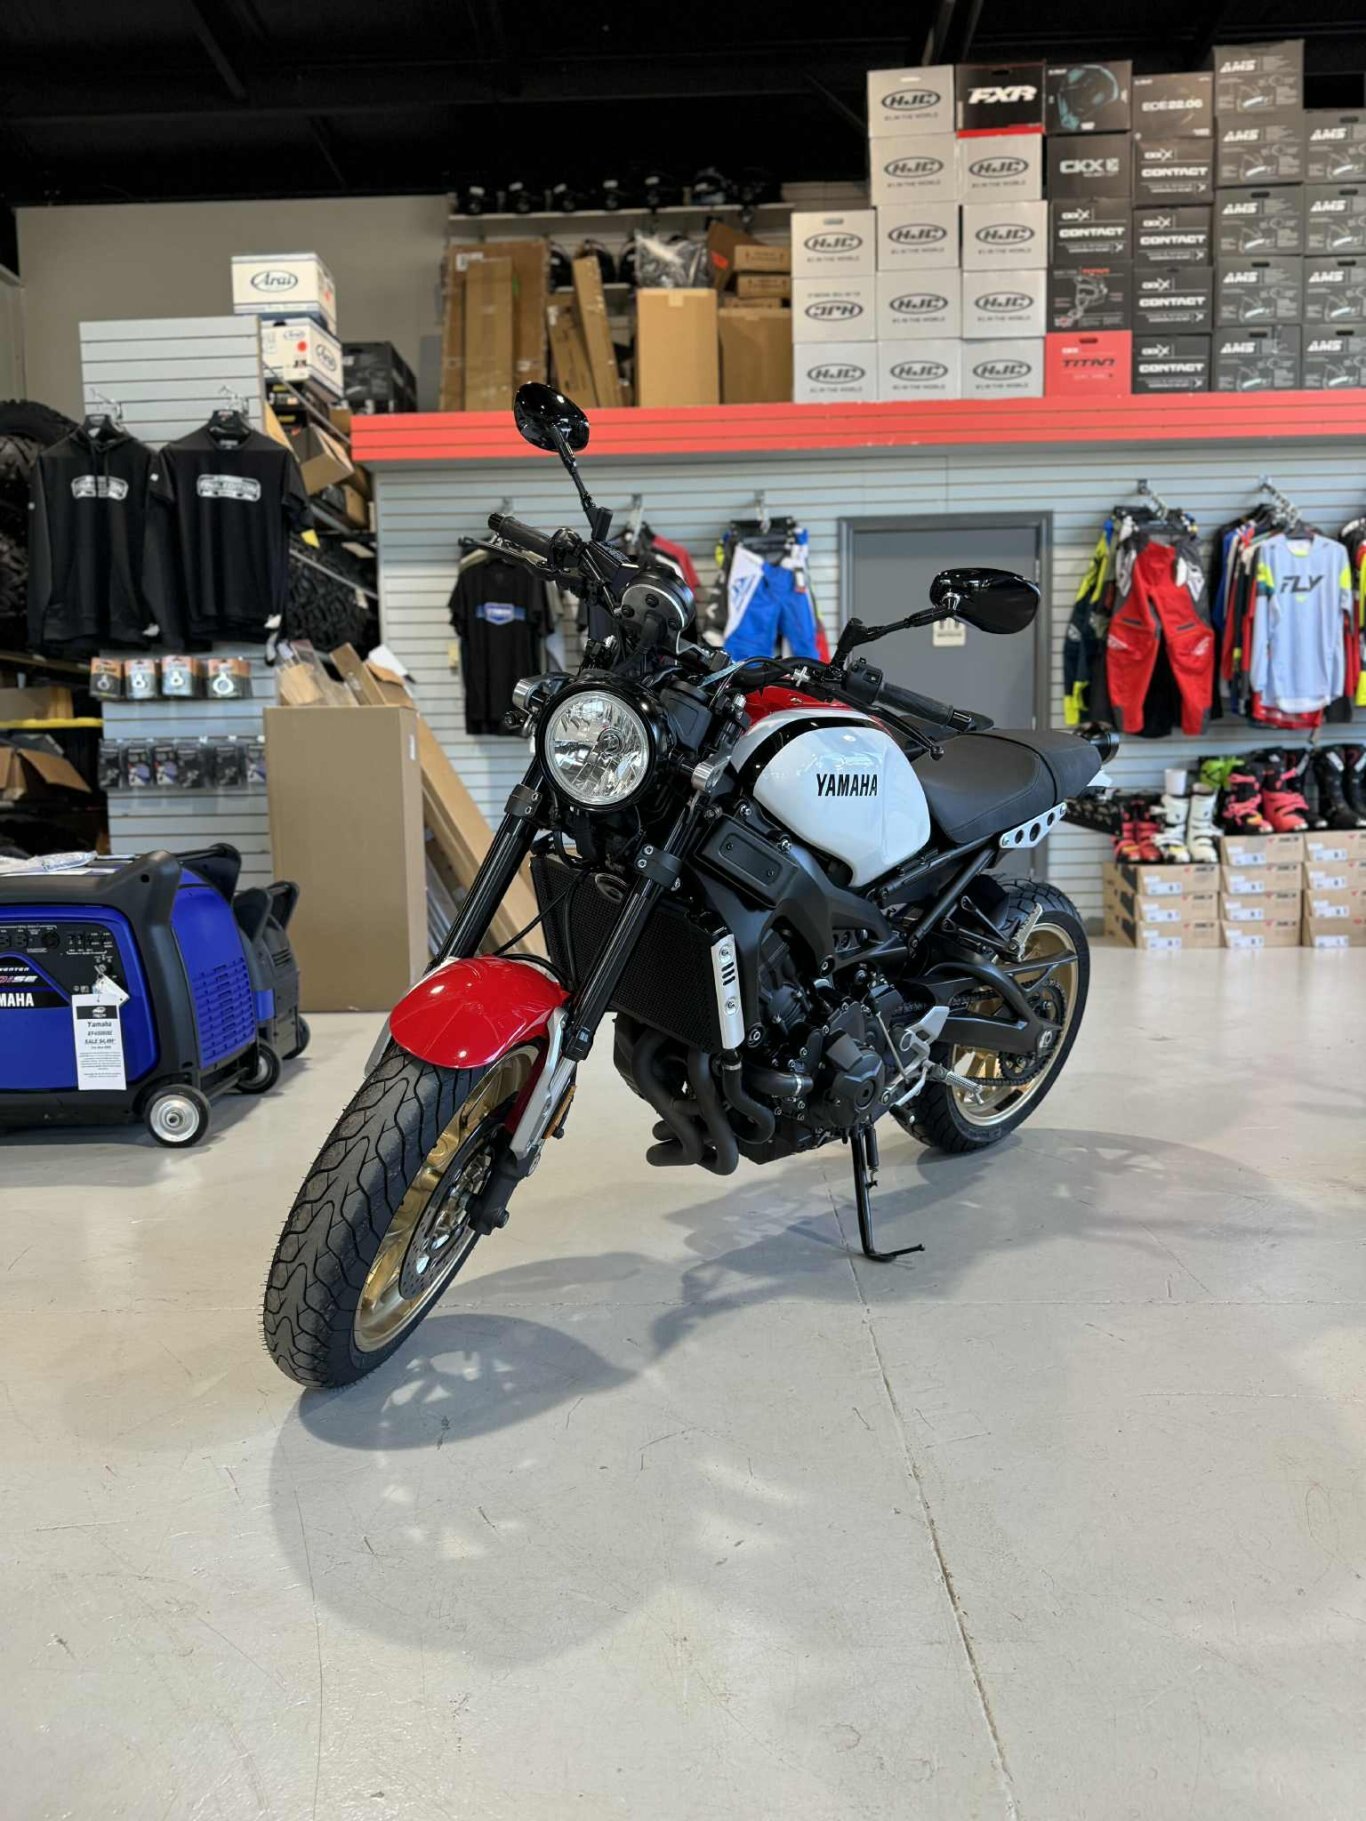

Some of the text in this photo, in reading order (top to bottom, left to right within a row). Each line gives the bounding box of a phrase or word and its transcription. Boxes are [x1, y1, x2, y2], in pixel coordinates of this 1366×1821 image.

[1220, 60, 1256, 73] AMS
[890, 94, 932, 106] HJC
[968, 85, 1038, 104] FXR
[1223, 129, 1260, 142] AMS
[1310, 128, 1347, 141] AMS
[893, 161, 935, 174] HJC
[978, 161, 1020, 174] HJC
[1060, 159, 1103, 174] CKX
[1142, 167, 1208, 178] CONTACT
[1222, 202, 1258, 215] AMS
[1310, 200, 1346, 212] AMS
[896, 229, 939, 241] HJC
[984, 229, 1026, 241] HJC
[1059, 227, 1126, 238] CONTACT
[812, 237, 854, 249] HJC
[1140, 235, 1206, 246] CONTACT
[1223, 272, 1258, 284] AMS
[1309, 271, 1344, 283] AMS
[898, 298, 940, 310] HJC
[984, 297, 1026, 309] HJC
[1139, 296, 1206, 308] CONTACT
[1220, 342, 1256, 354] AMS
[1307, 340, 1342, 352] AMS
[816, 368, 858, 380] HJC
[898, 366, 940, 378] HJC
[981, 364, 1024, 376] HJC
[1139, 364, 1205, 374] CONTACT
[1280, 576, 1324, 593] FLY
[816, 774, 878, 796] YAMAHA
